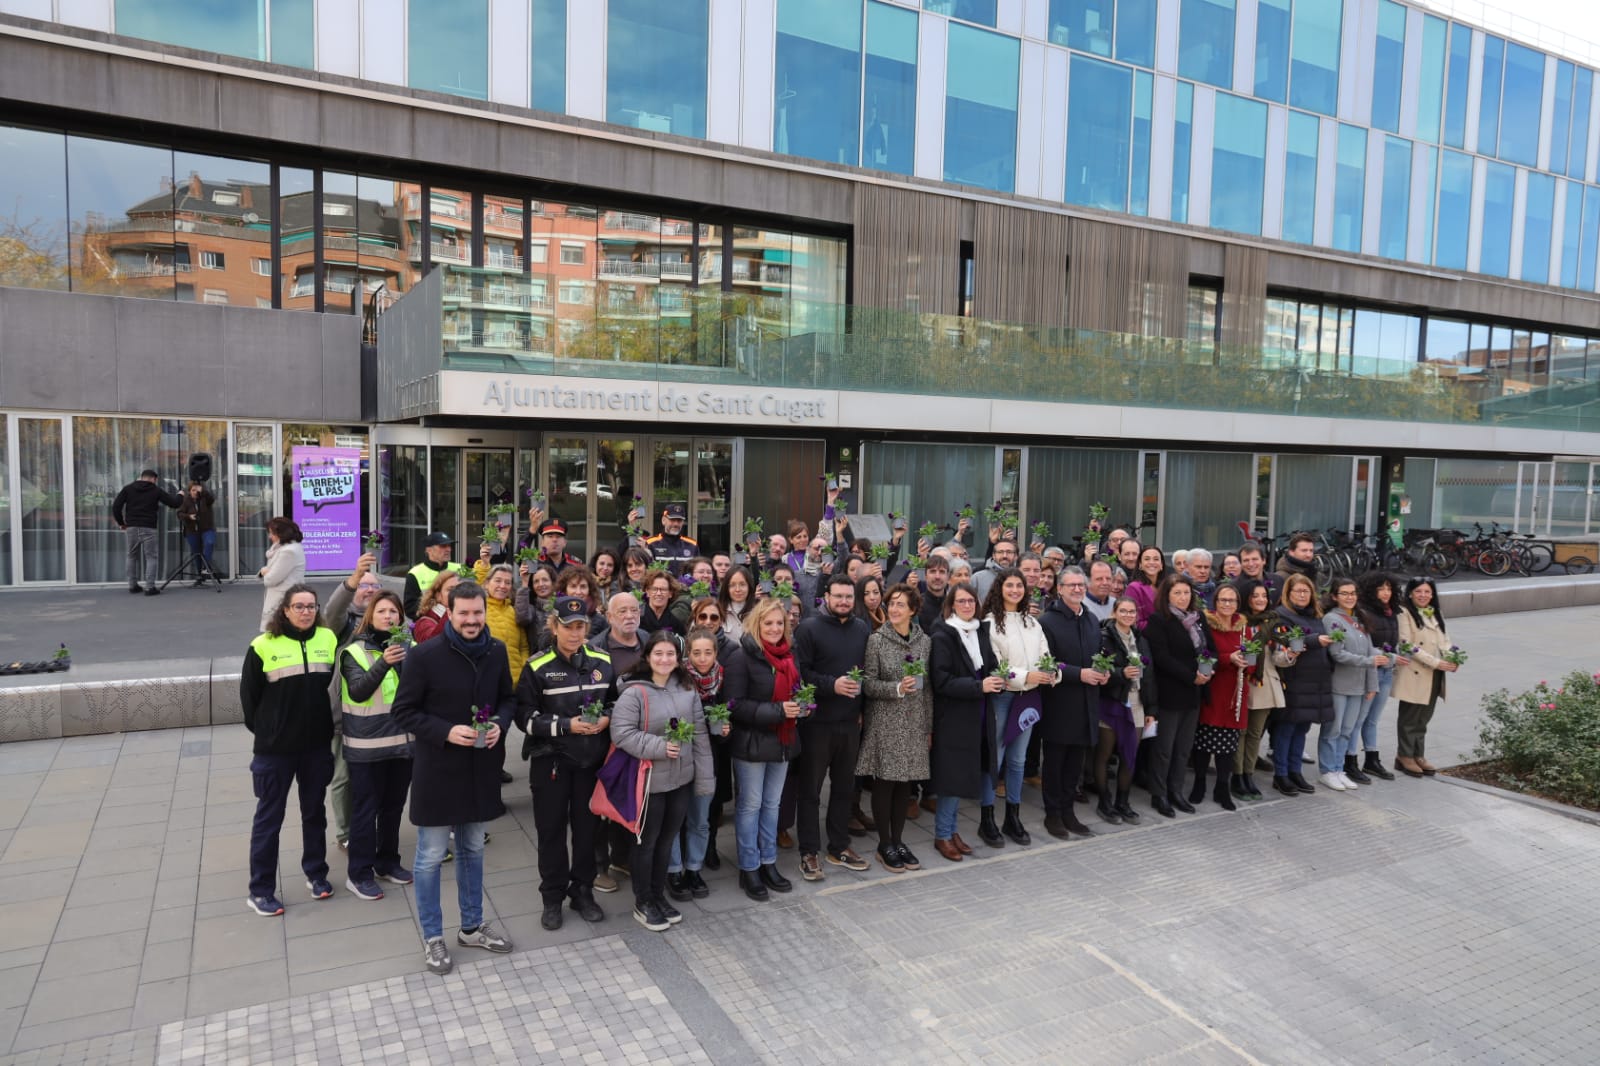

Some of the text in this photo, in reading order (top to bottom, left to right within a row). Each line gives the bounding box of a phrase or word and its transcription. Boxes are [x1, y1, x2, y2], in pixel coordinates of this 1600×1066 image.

[483, 380, 826, 423] Ajuntament de Sant Cugat
[302, 476, 352, 488] BARREM-LI
[313, 486, 343, 497] EL PAS
